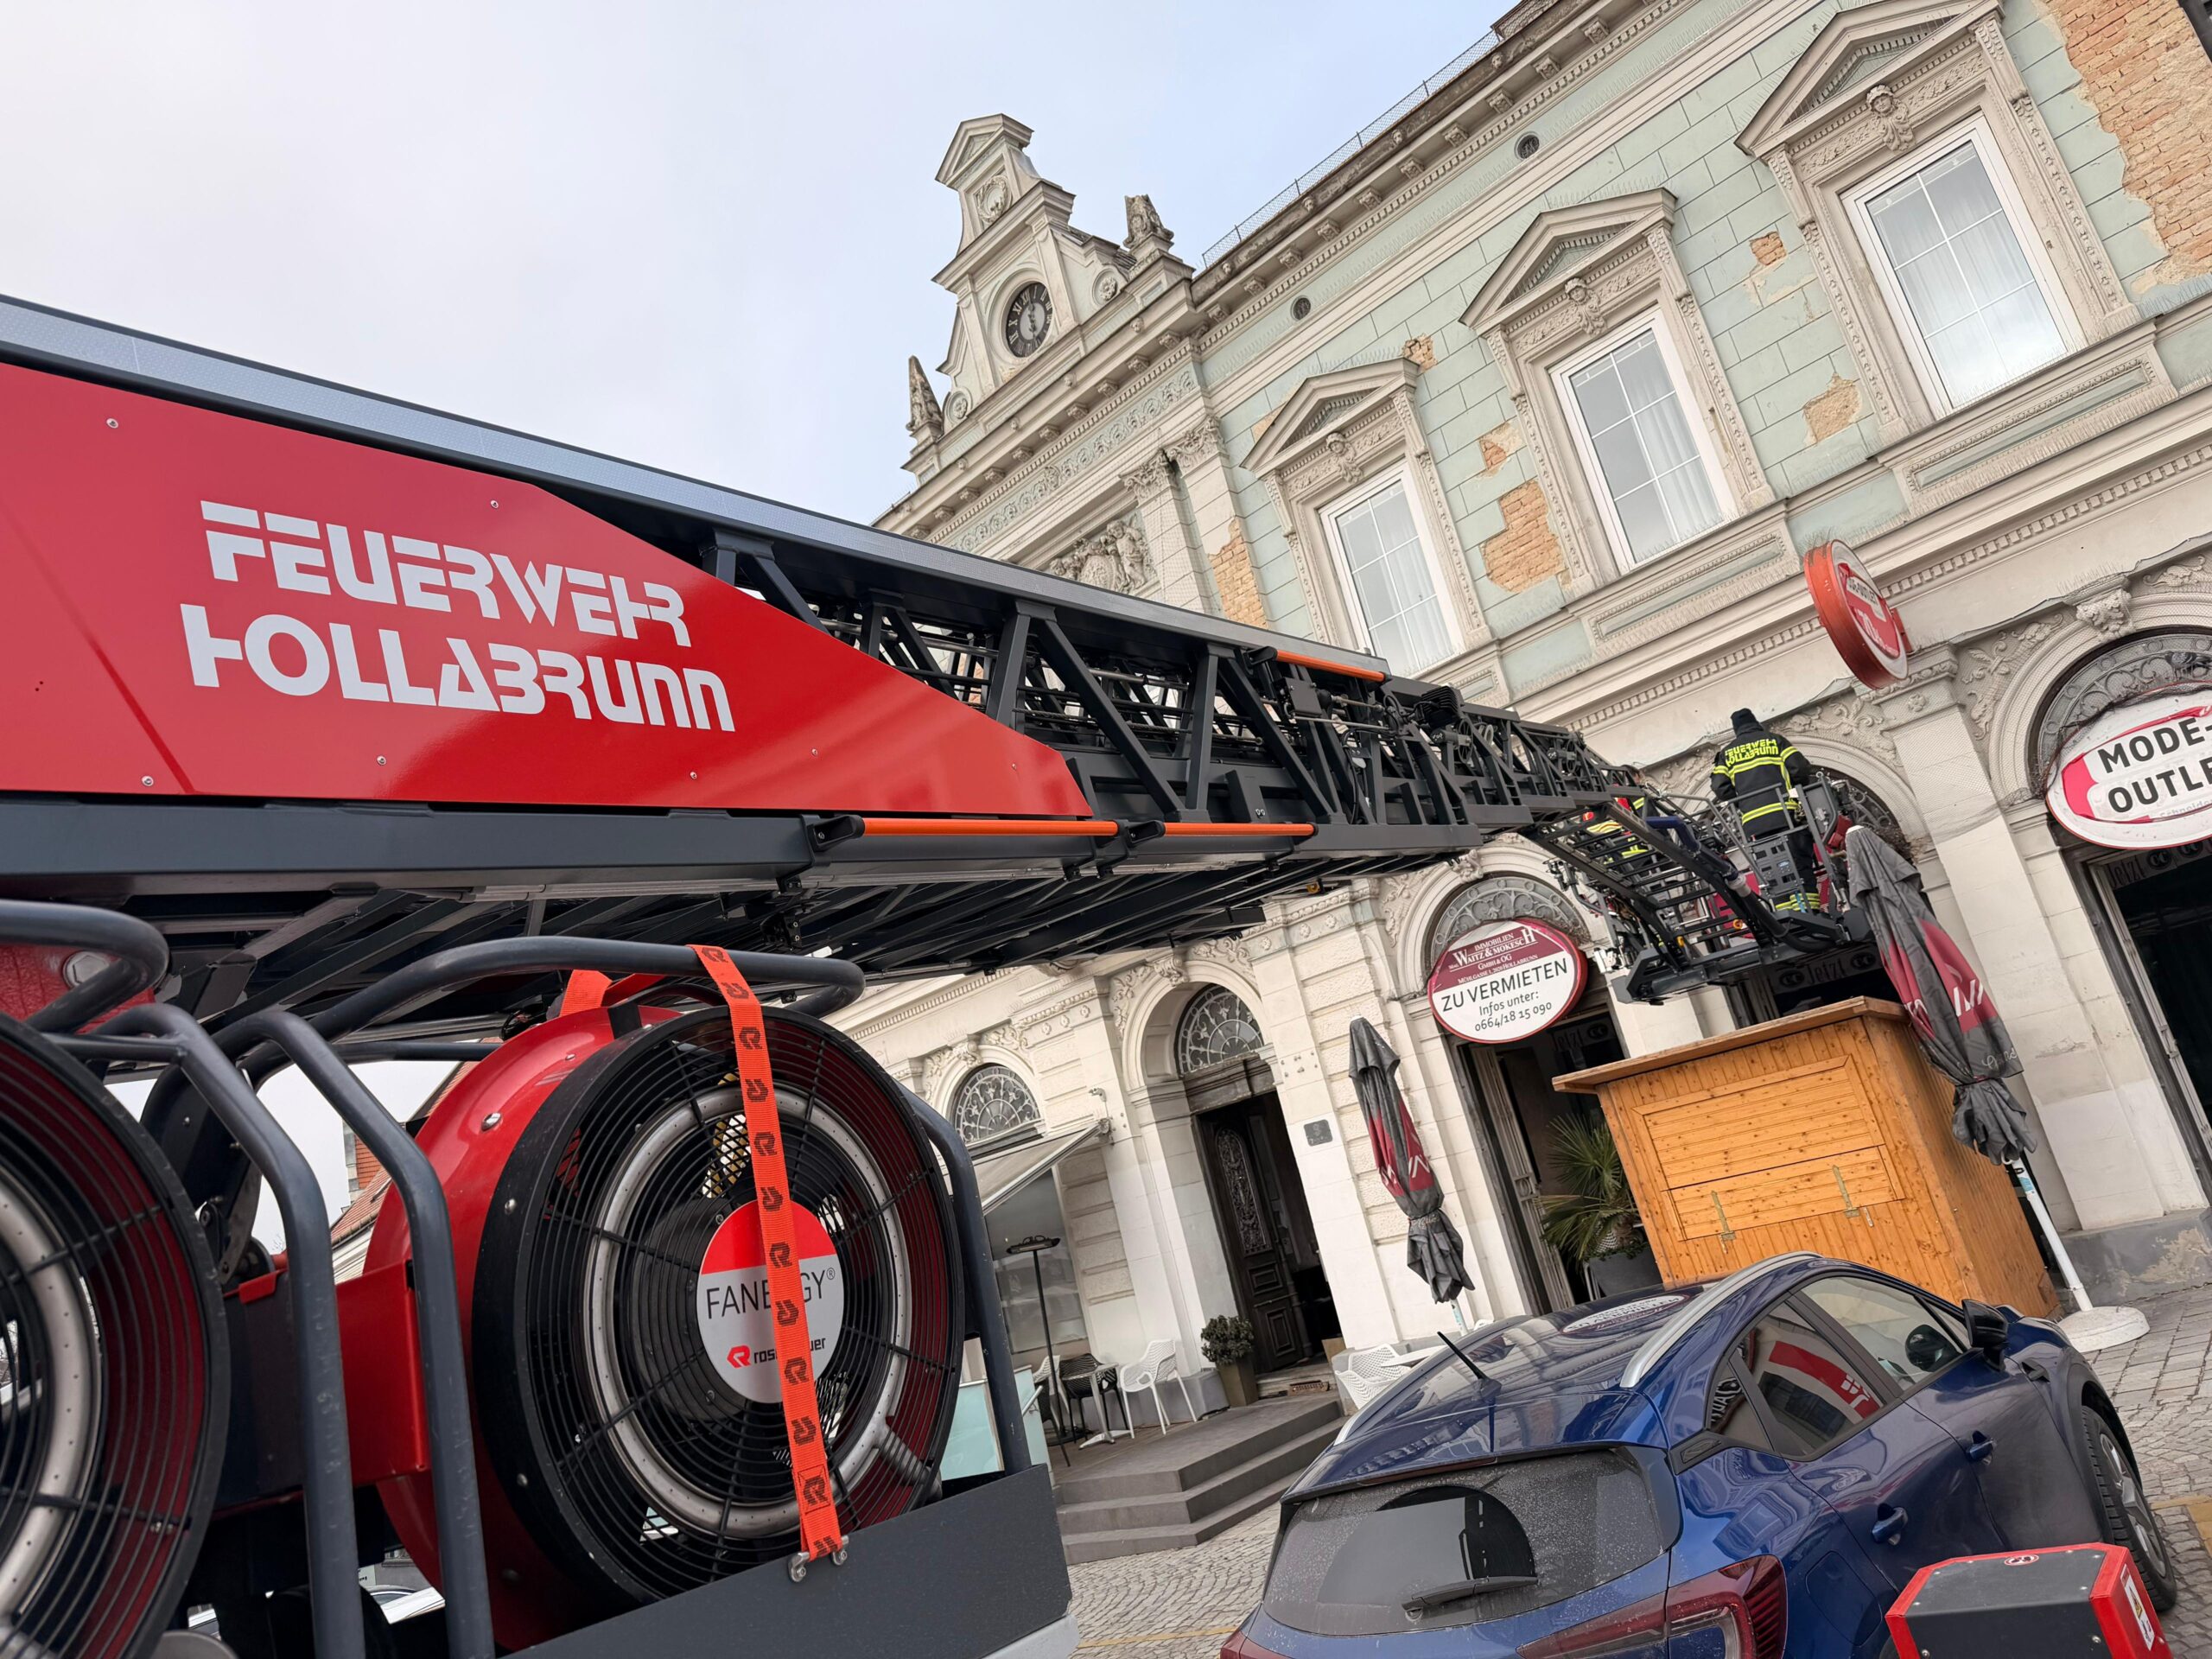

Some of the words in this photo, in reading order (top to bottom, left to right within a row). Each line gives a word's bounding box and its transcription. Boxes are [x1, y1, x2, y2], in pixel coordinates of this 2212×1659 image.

[200, 500, 691, 647] FEUERWEHR
[181, 603, 735, 732] HOLLABRUNN
[1725, 739, 1777, 757] FEUERWEHR
[2098, 717, 2212, 773] MODE-
[1452, 949, 1485, 967] WAITZ
[1484, 948, 1493, 957] &
[1493, 928, 1536, 955] MOKESCH
[1474, 932, 1515, 951] IMMOBILIEN
[1440, 991, 1464, 1012] ZU
[1467, 957, 1568, 1003] VERMIETEN
[1478, 1001, 1505, 1017] Infos
[1507, 990, 1540, 1007] unter:
[1474, 1010, 1516, 1032] 0664/18
[1518, 1008, 1531, 1020] 15
[1533, 1001, 1552, 1016] 090
